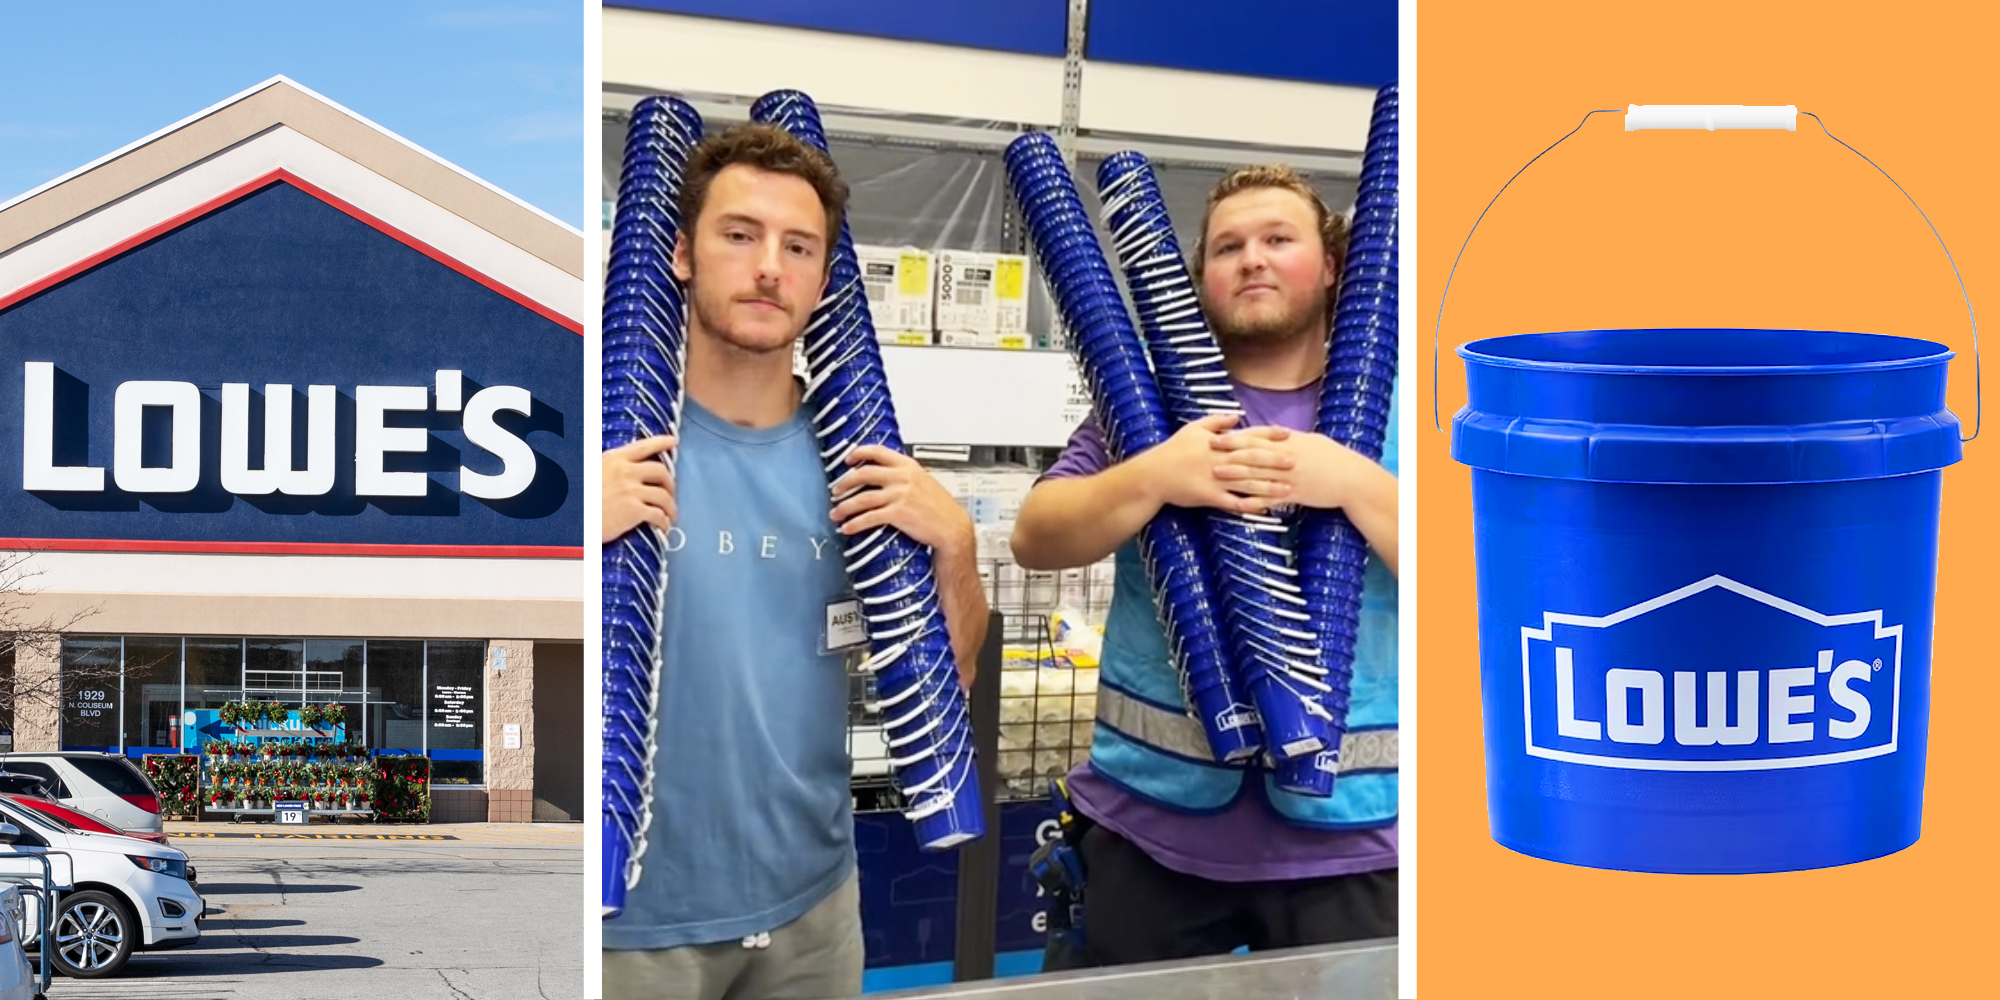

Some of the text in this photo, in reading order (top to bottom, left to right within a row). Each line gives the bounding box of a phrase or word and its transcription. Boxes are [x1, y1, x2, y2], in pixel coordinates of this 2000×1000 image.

[23, 361, 537, 499] LOWE'S
[668, 527, 828, 560] OBEY
[832, 611, 859, 626] AUST
[78, 690, 105, 700] 1929
[1556, 647, 1871, 746] LOWE'S
[284, 812, 296, 821] 19
